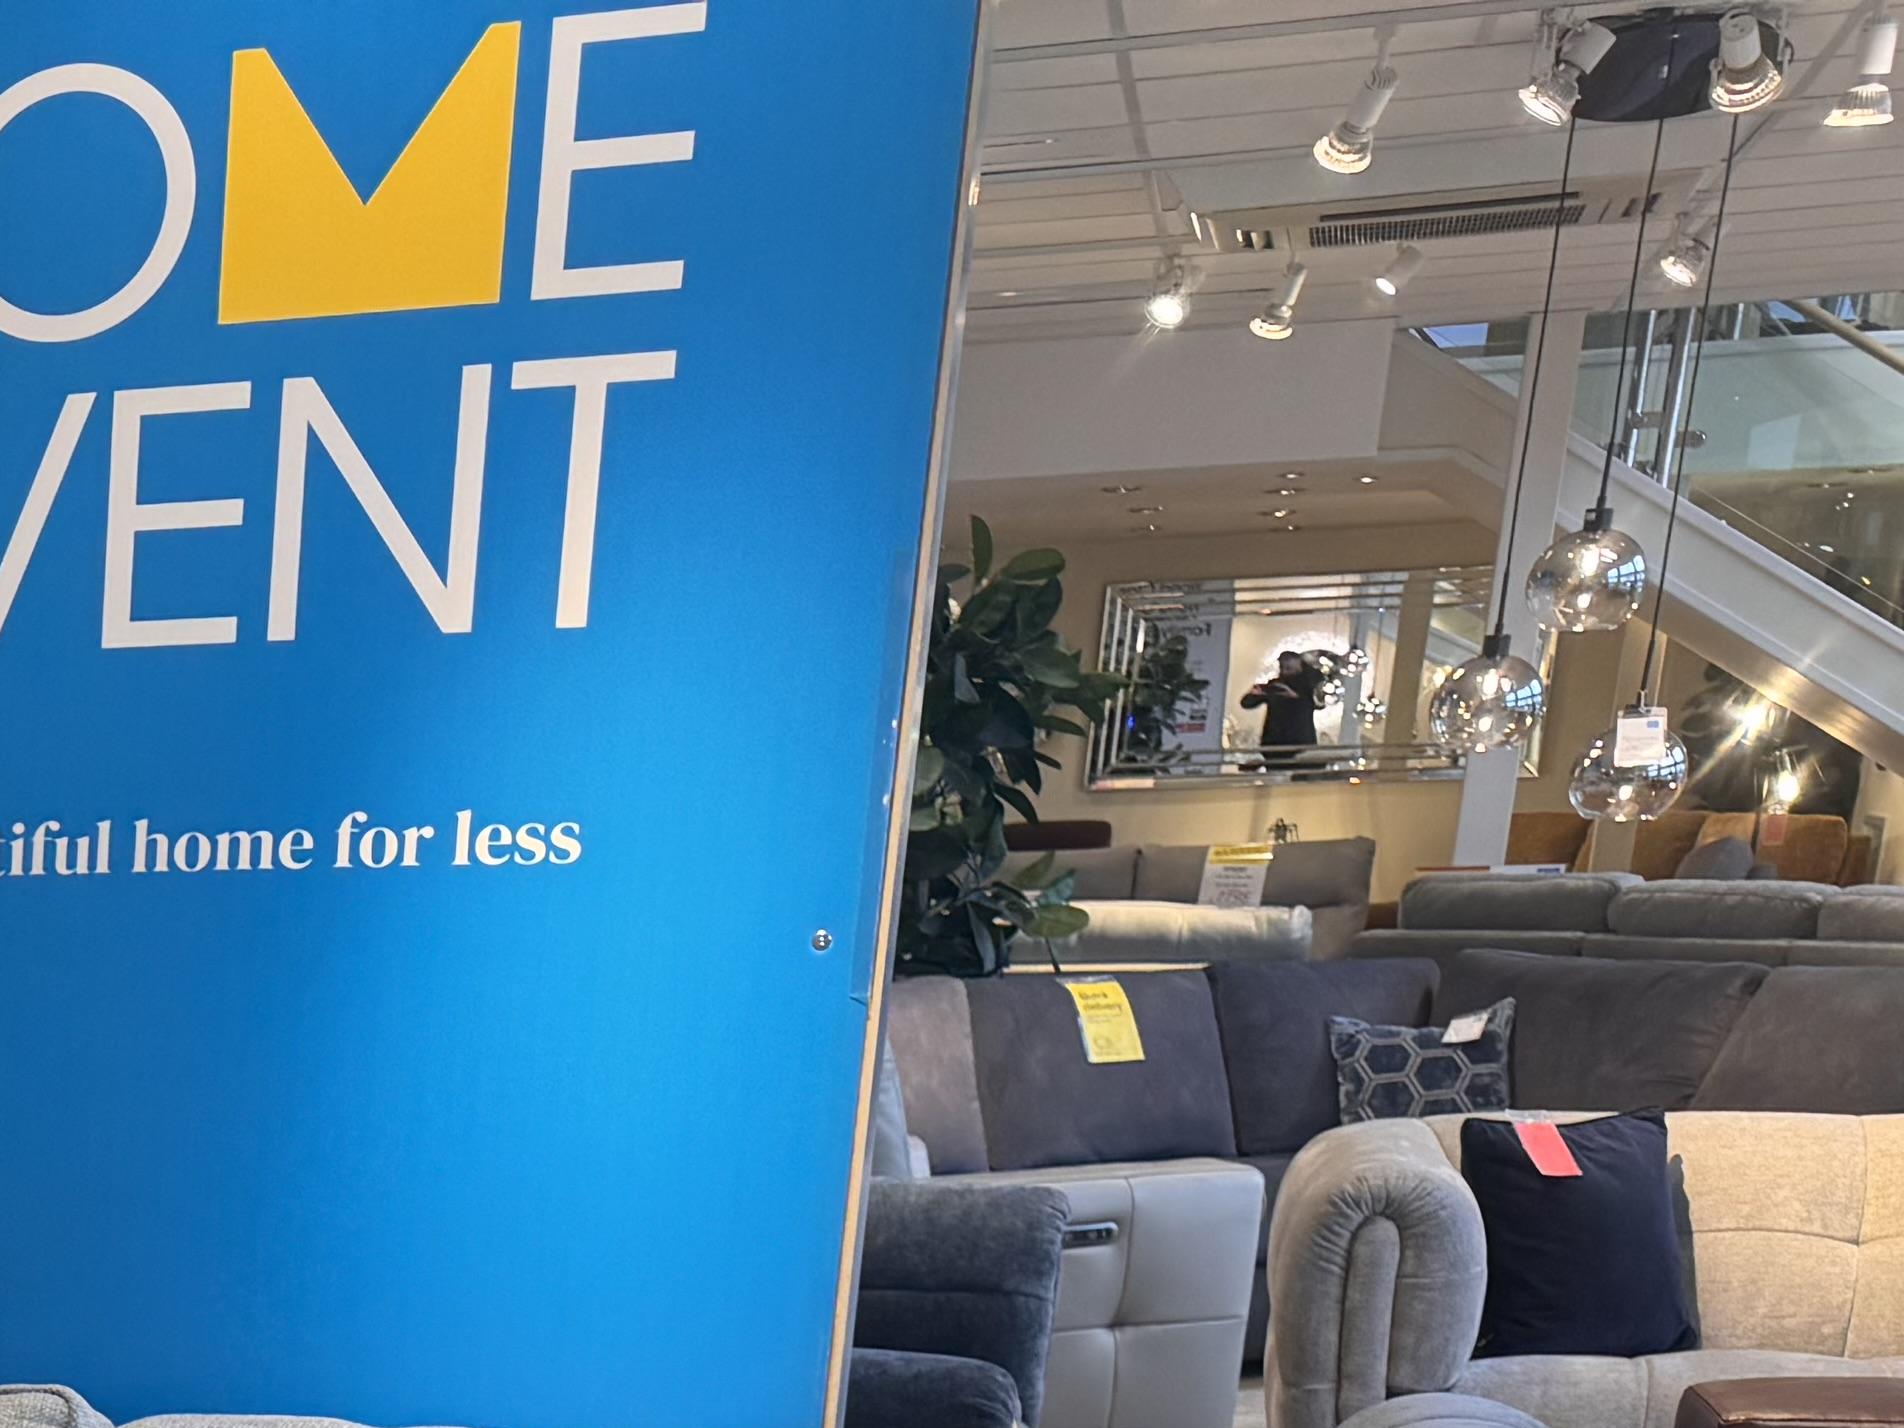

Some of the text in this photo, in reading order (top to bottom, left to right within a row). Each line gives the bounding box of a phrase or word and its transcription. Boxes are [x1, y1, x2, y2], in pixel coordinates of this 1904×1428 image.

[132, 818, 313, 874] home
[334, 811, 434, 869] for
[452, 808, 583, 866] less
